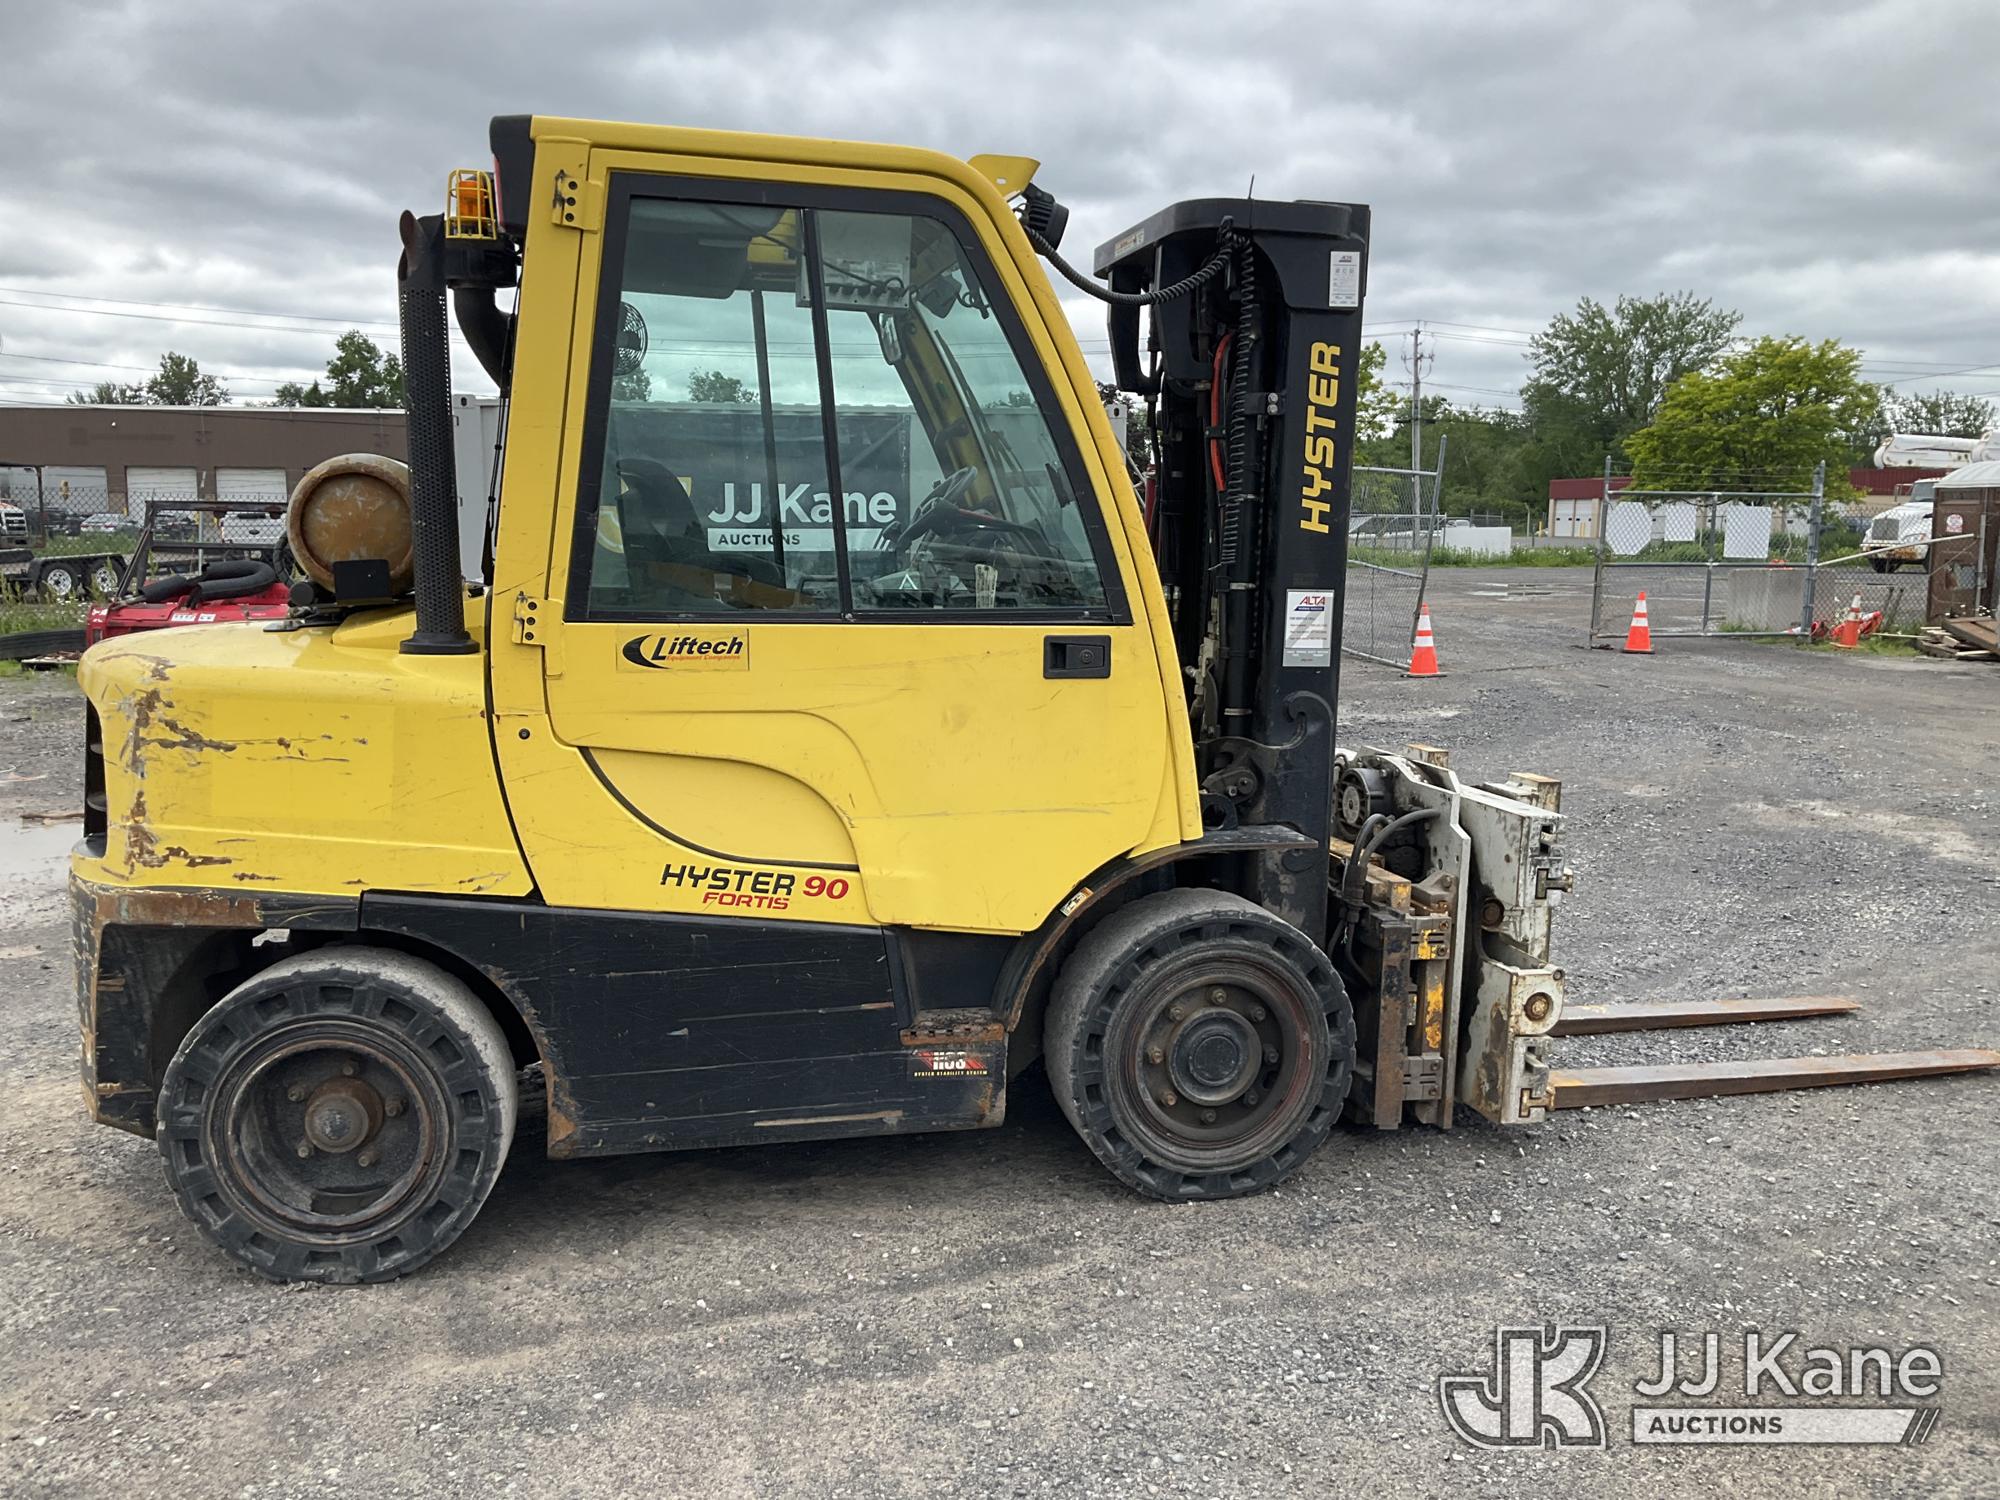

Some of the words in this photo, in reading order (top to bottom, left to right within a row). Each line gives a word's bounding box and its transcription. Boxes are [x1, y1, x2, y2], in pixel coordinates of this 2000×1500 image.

[1300, 341, 1341, 534] HYSTER
[707, 482, 762, 523] JJ
[778, 483, 897, 524] Kane
[1300, 596, 1326, 606] ALTA
[651, 637, 743, 660] Liftech
[660, 863, 796, 896] HYSTER
[803, 876, 849, 899] 90
[703, 892, 790, 910] FORTIS
